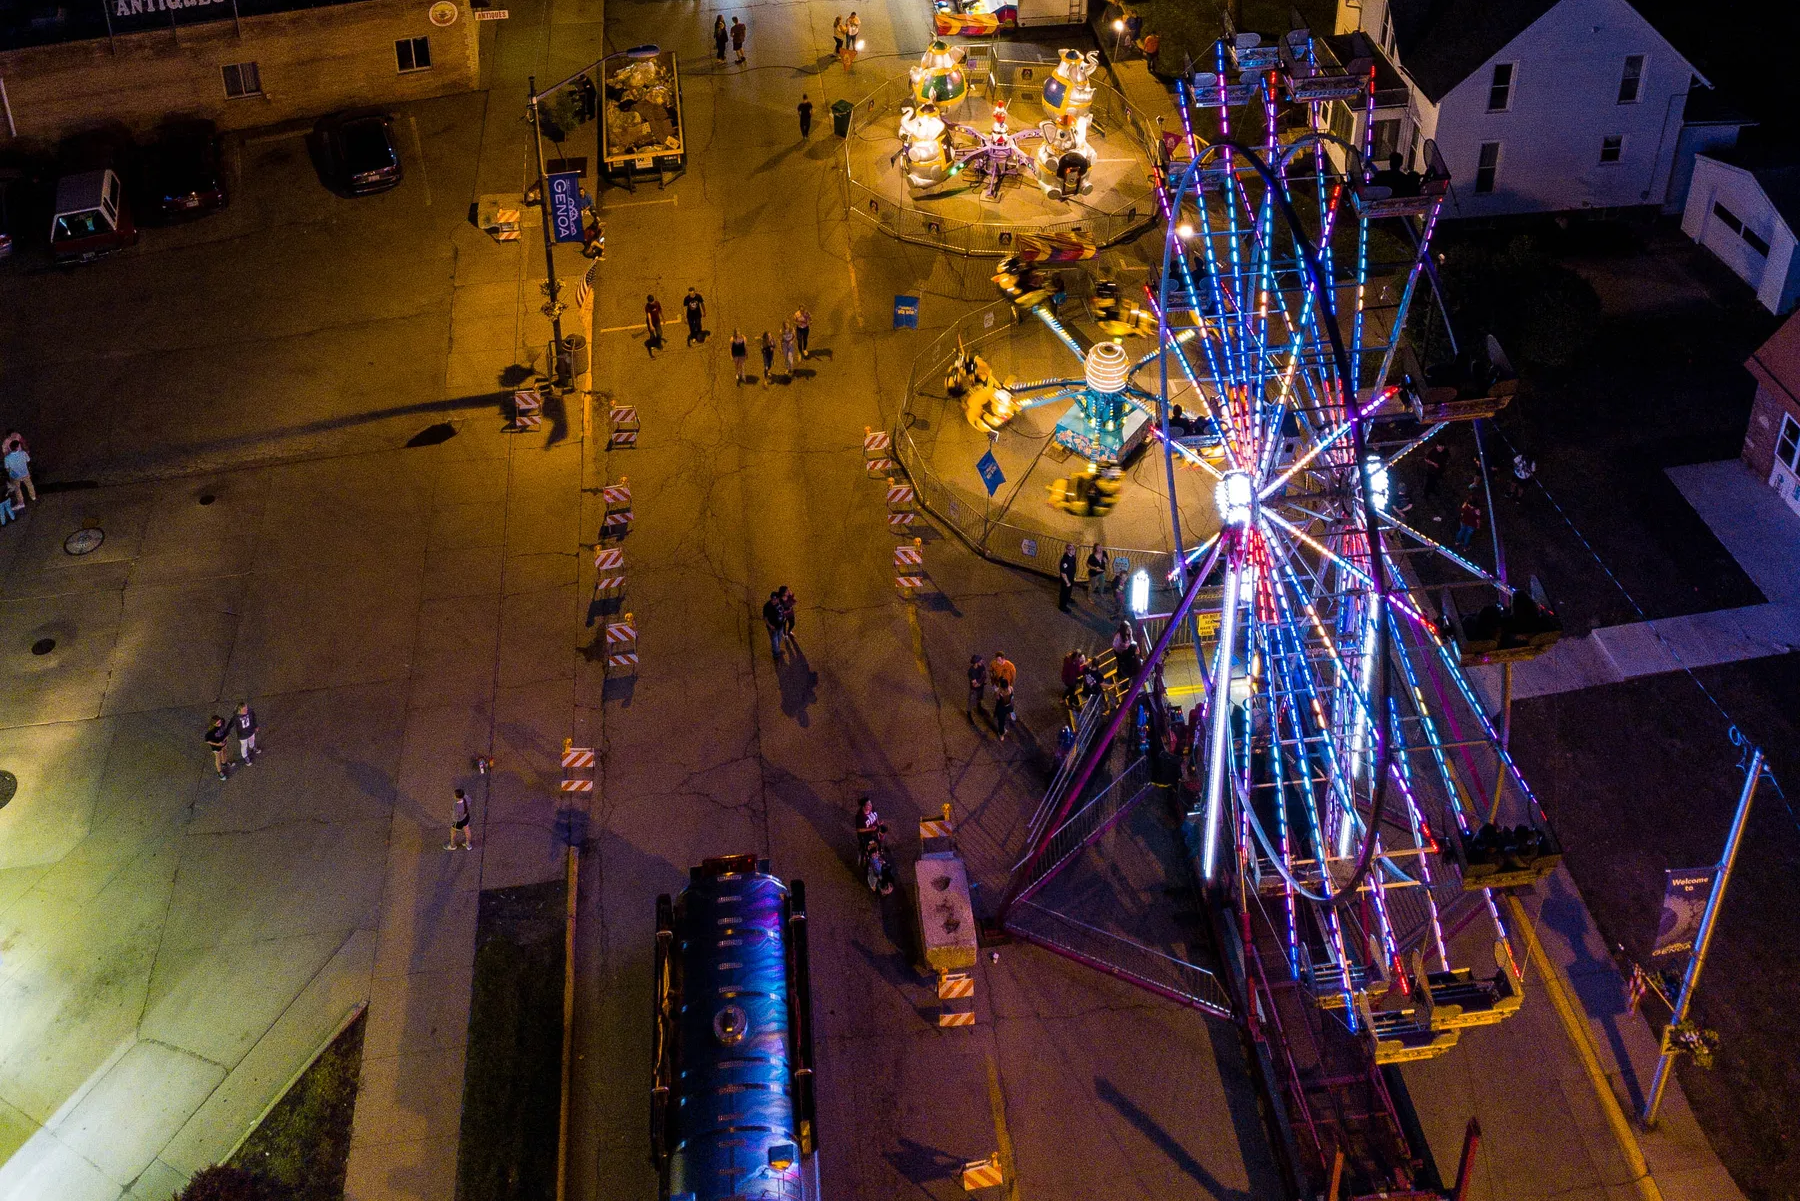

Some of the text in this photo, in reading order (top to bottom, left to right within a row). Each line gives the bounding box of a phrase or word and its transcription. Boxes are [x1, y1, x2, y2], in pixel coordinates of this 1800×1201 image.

[477, 11, 506, 20] ANTIQUES
[554, 179, 570, 238] GENOA
[1672, 877, 1709, 886] Welcome
